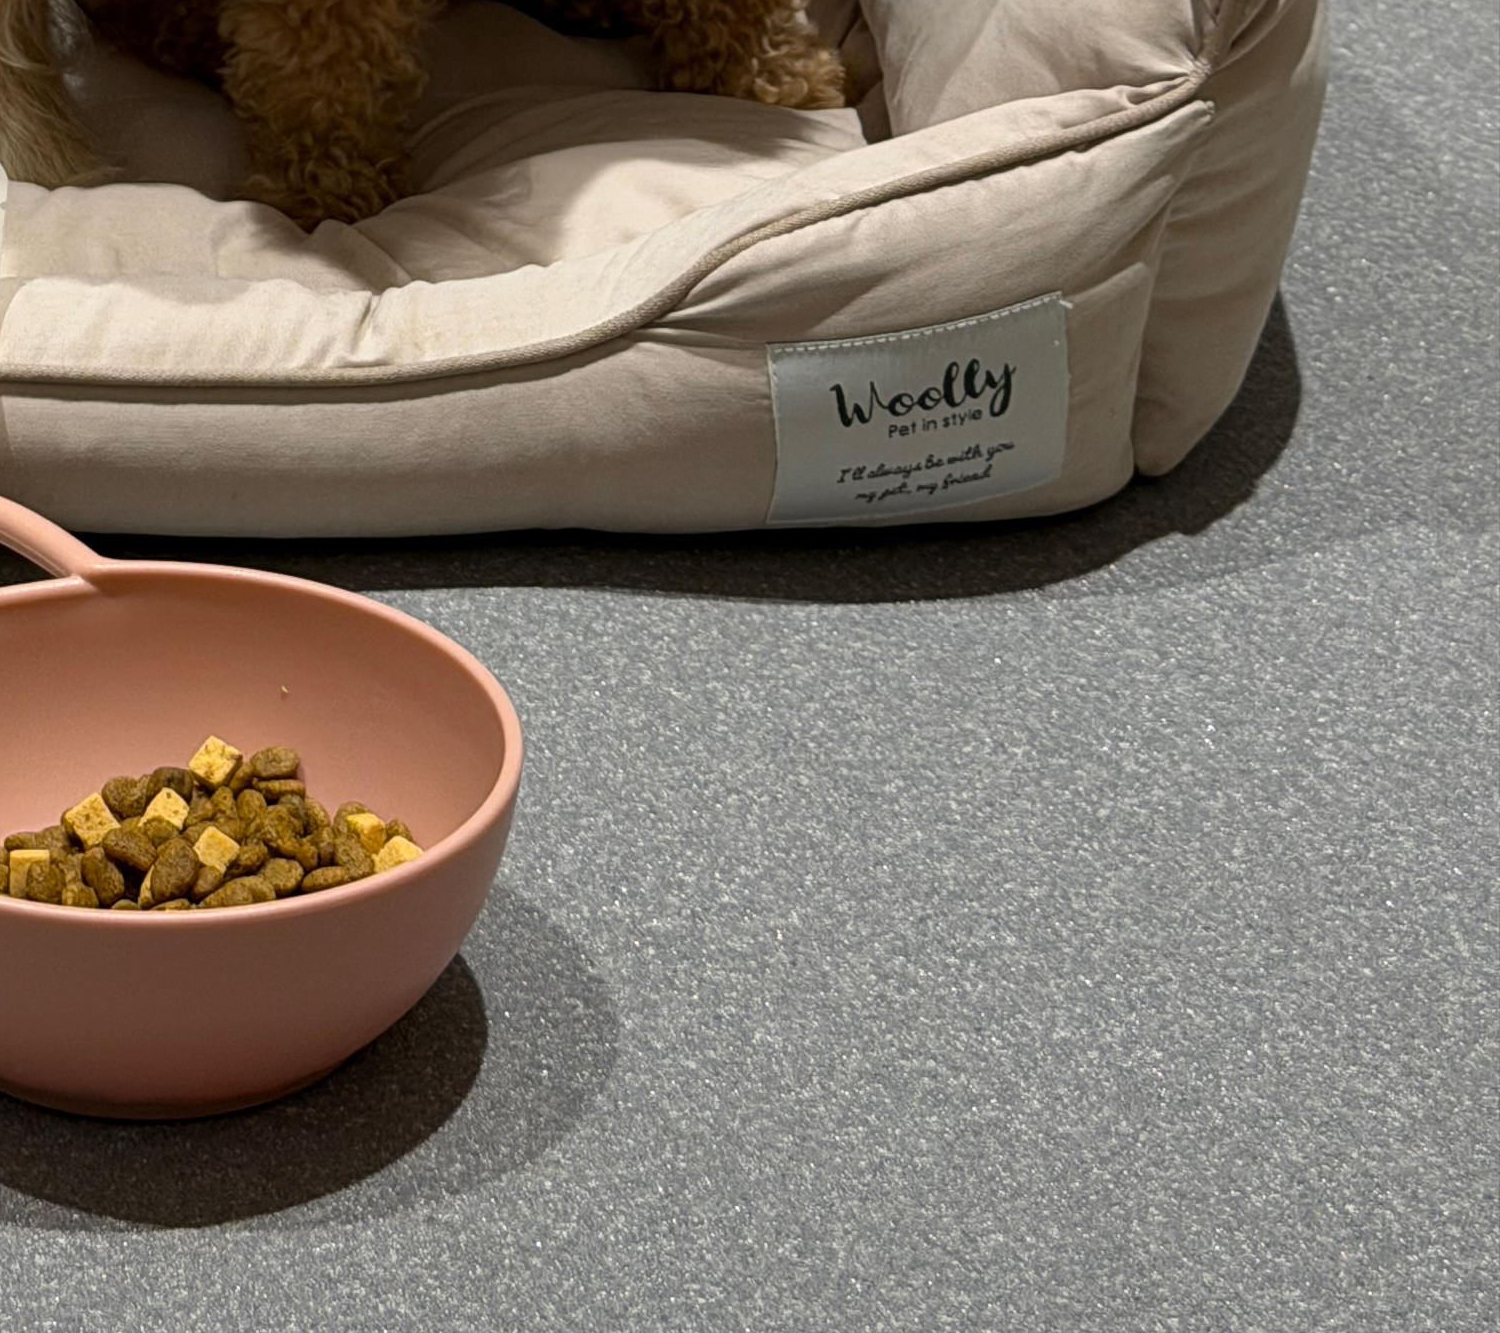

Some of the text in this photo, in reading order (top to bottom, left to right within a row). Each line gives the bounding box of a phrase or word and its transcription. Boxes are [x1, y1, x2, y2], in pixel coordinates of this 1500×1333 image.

[829, 358, 1016, 427] Woolly
[888, 408, 983, 438] Pet in style
[947, 444, 983, 465] with
